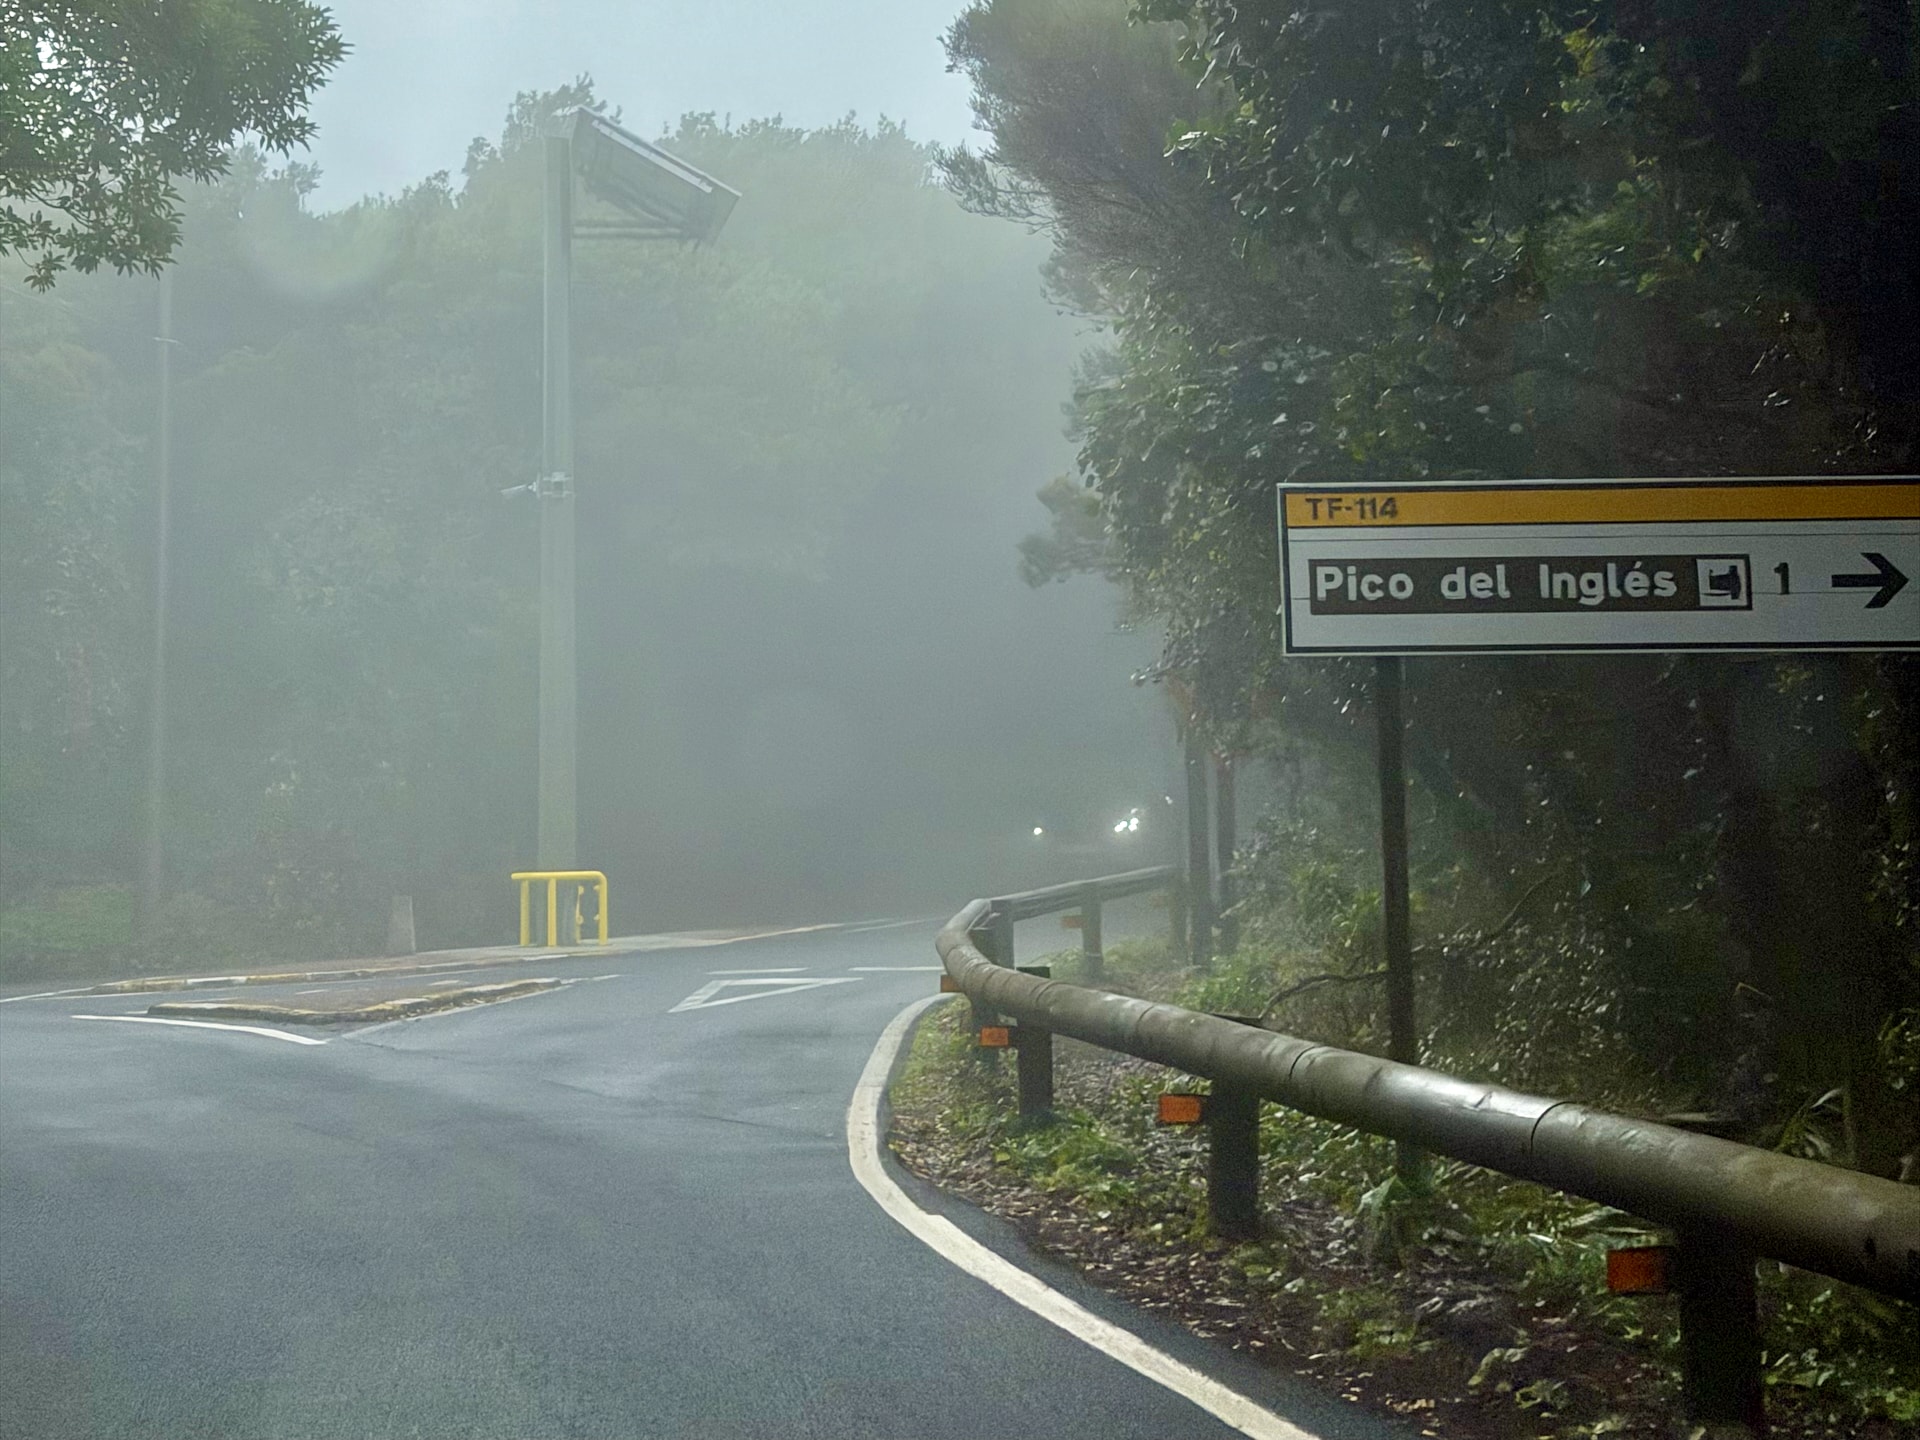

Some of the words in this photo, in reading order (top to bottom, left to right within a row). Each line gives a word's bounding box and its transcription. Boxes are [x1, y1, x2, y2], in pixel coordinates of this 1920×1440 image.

[1305, 496, 1398, 521] TF-114
[1315, 566, 1414, 601] Pico
[1440, 564, 1510, 600] del
[1539, 560, 1677, 606] Inglés
[1772, 562, 1790, 596] 1
